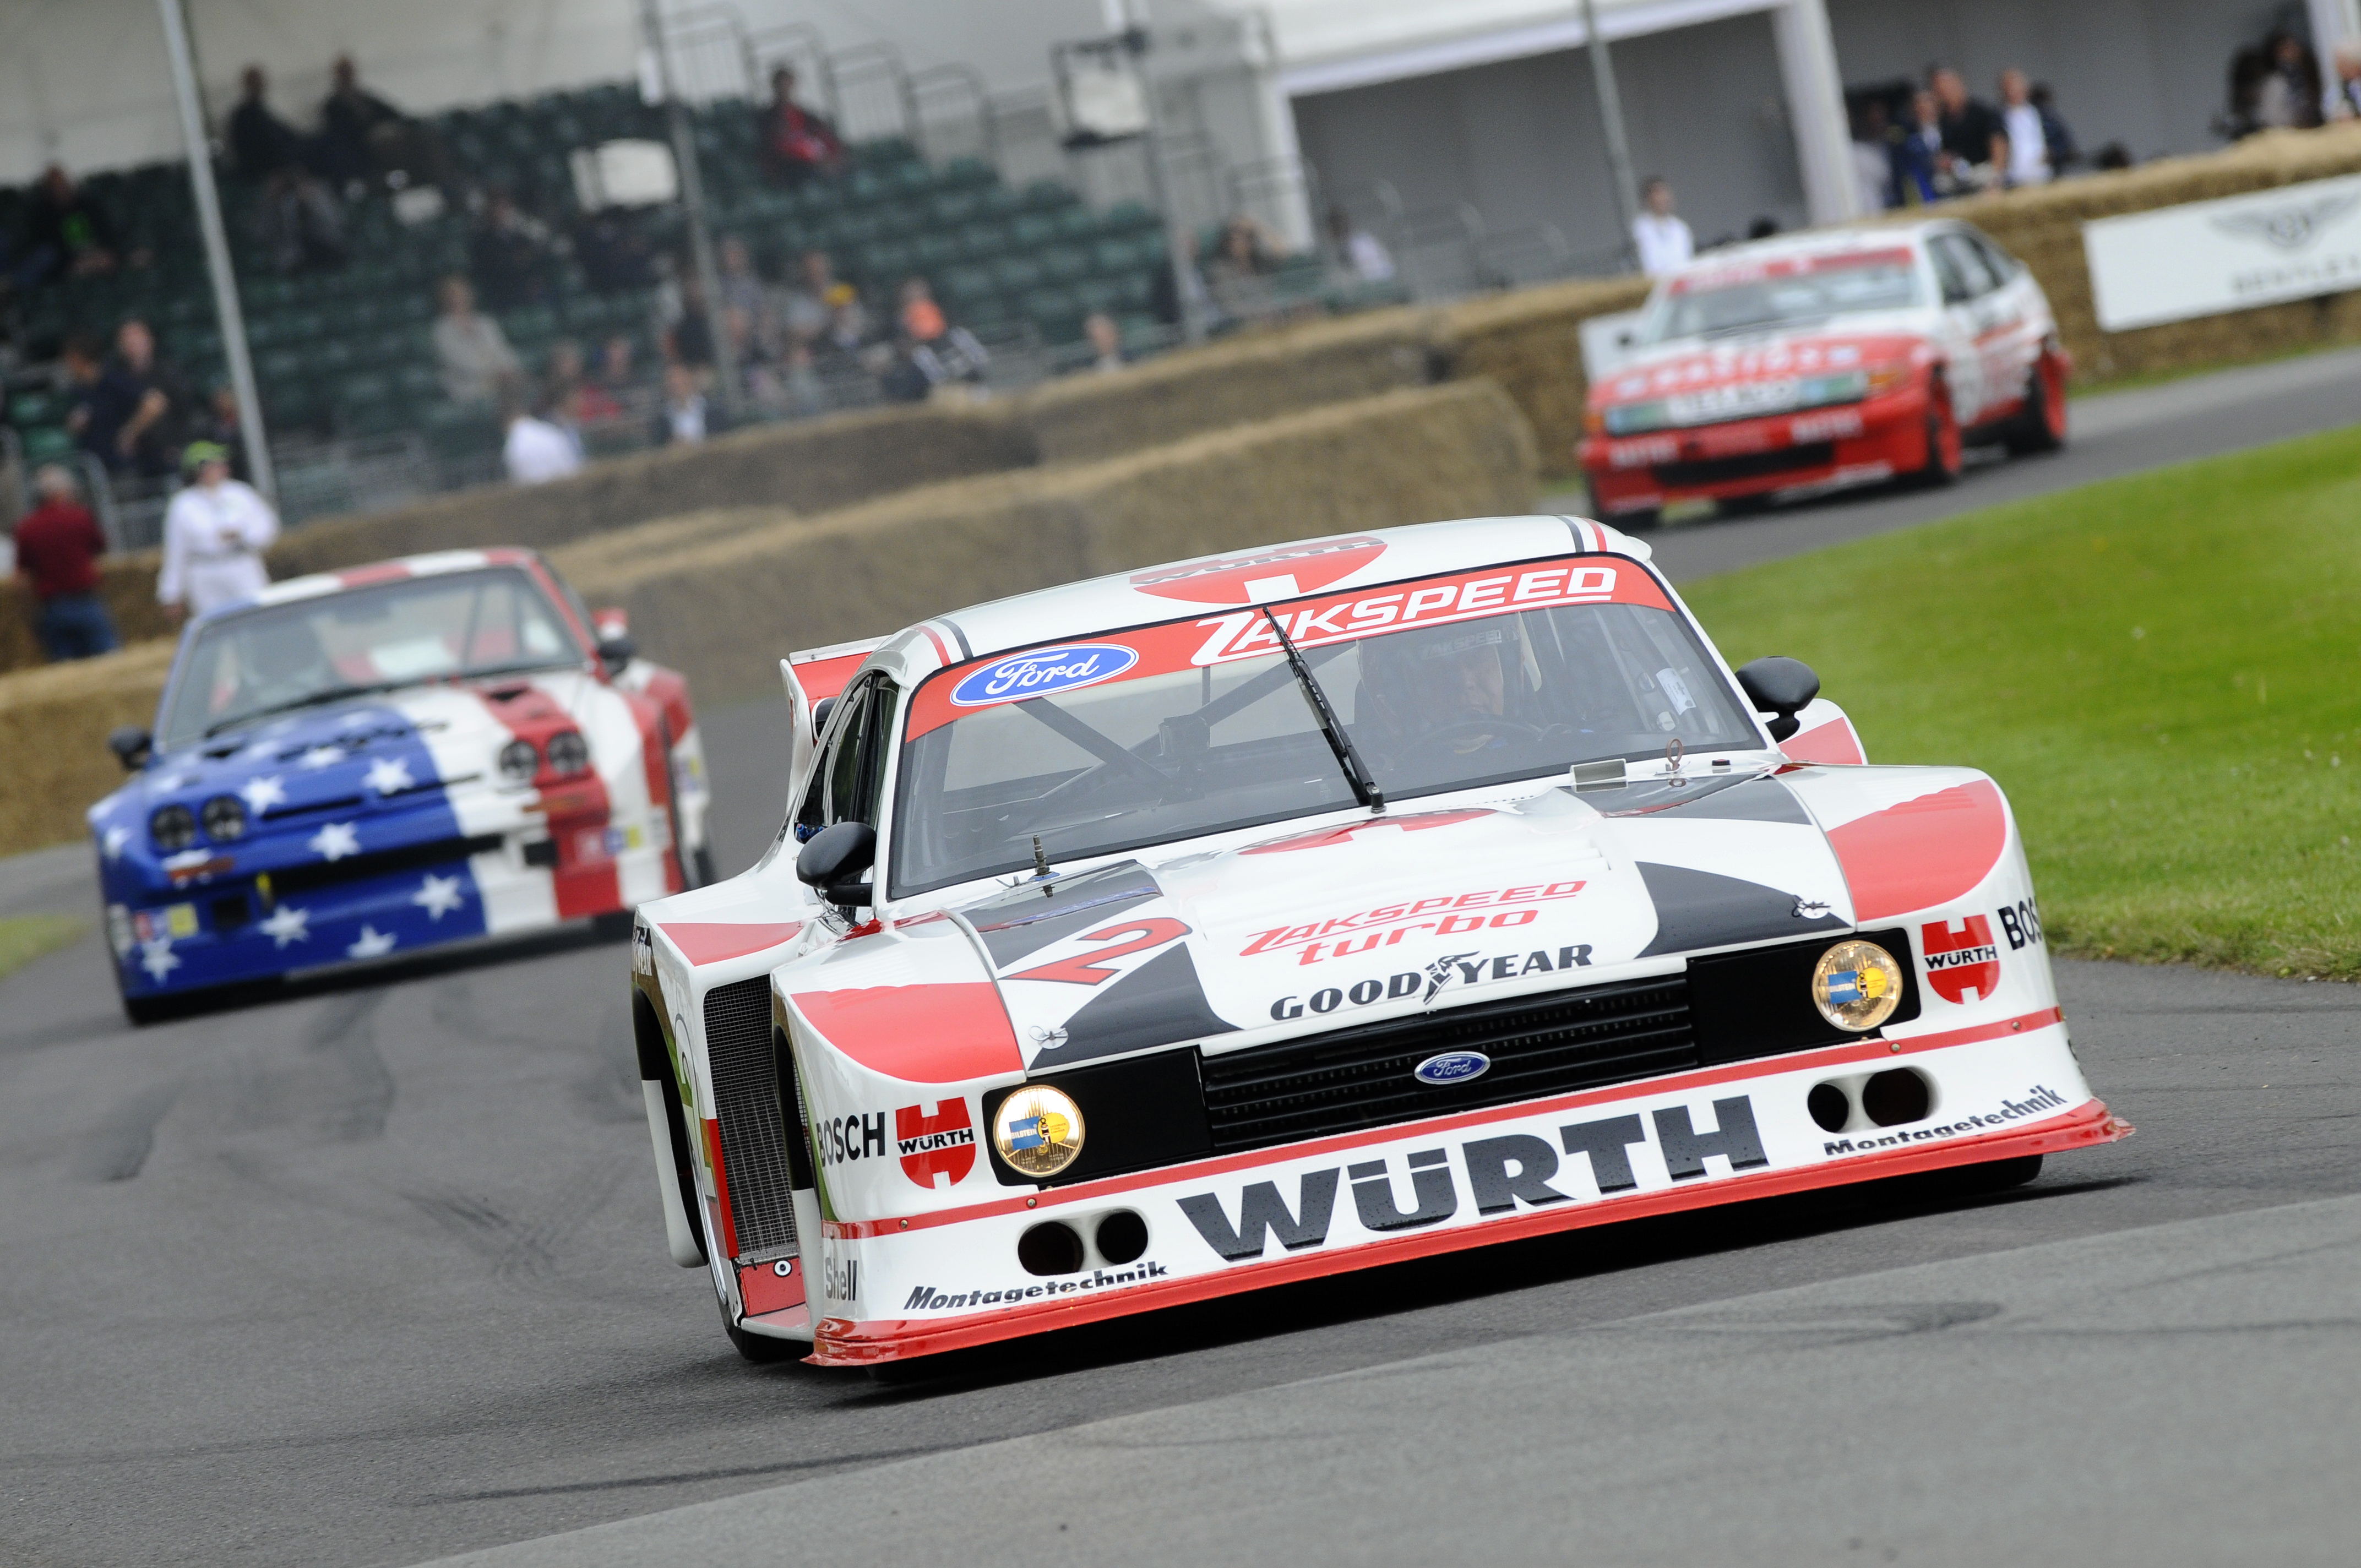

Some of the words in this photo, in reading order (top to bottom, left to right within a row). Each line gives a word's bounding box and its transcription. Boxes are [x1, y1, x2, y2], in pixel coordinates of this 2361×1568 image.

[1190, 566, 1618, 666] ZAKSPEED
[984, 652, 1101, 695] Ford
[1239, 880, 1588, 957] ZAKSPEED
[1297, 910, 1538, 966] turbo
[997, 917, 1193, 987] 2
[1924, 944, 1998, 970] WÜRTH
[1433, 1057, 1472, 1077] Ford
[815, 1112, 886, 1168] BOSCH
[897, 1128, 975, 1156] WÜRTH
[1823, 1084, 2068, 1156] Montagetechnik
[1174, 1093, 1771, 1263] WÜRTH
[825, 1256, 857, 1301] Shell
[904, 1261, 1169, 1311] Montagetechnik
